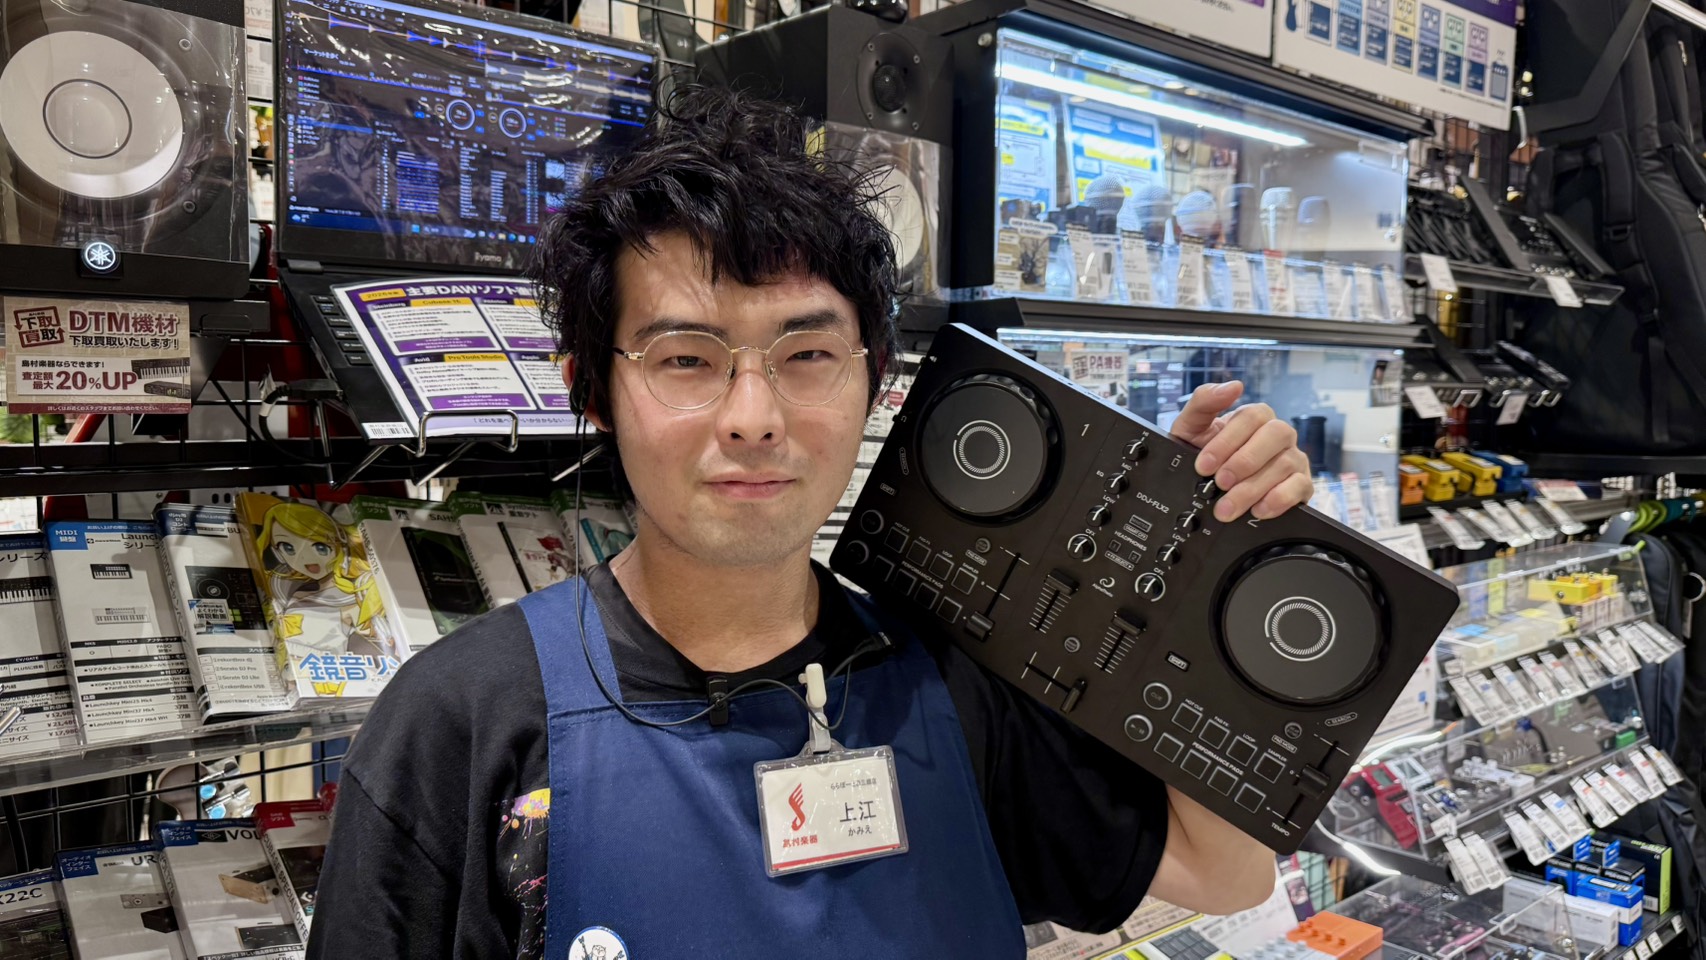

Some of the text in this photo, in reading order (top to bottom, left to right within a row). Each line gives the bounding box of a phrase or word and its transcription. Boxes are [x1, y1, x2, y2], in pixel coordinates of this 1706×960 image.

[69, 310, 179, 335] DTM機材
[22, 371, 53, 381] 査定額
[56, 370, 138, 391] 20%UP
[33, 381, 54, 390] 最大
[1081, 423, 1090, 437] 1
[1121, 462, 1132, 471] MID
[1096, 469, 1105, 478] EQ
[1102, 494, 1116, 504] LOW
[1136, 491, 1170, 514] DDJ-FLX2
[1191, 500, 1204, 510] MID
[1085, 528, 1096, 537] CFX
[1202, 528, 1212, 536] EQ
[1114, 530, 1147, 552] HEADPHONES
[1172, 533, 1186, 544] LOW
[901, 560, 944, 589] PERFORMANCE PADS
[1153, 567, 1165, 576] CFX
[1242, 733, 1256, 743] LOOP
[1191, 741, 1244, 775] PERFORMANCE PADS
[1267, 748, 1288, 762] SAMPLER
[840, 801, 877, 823] 上江
[847, 825, 873, 837] かみえ
[1271, 821, 1290, 836] TEMPO
[782, 834, 819, 848] 島村楽器
[131, 854, 158, 866] UR
[263, 834, 309, 943] CUBASE SPECIAL OFFE
